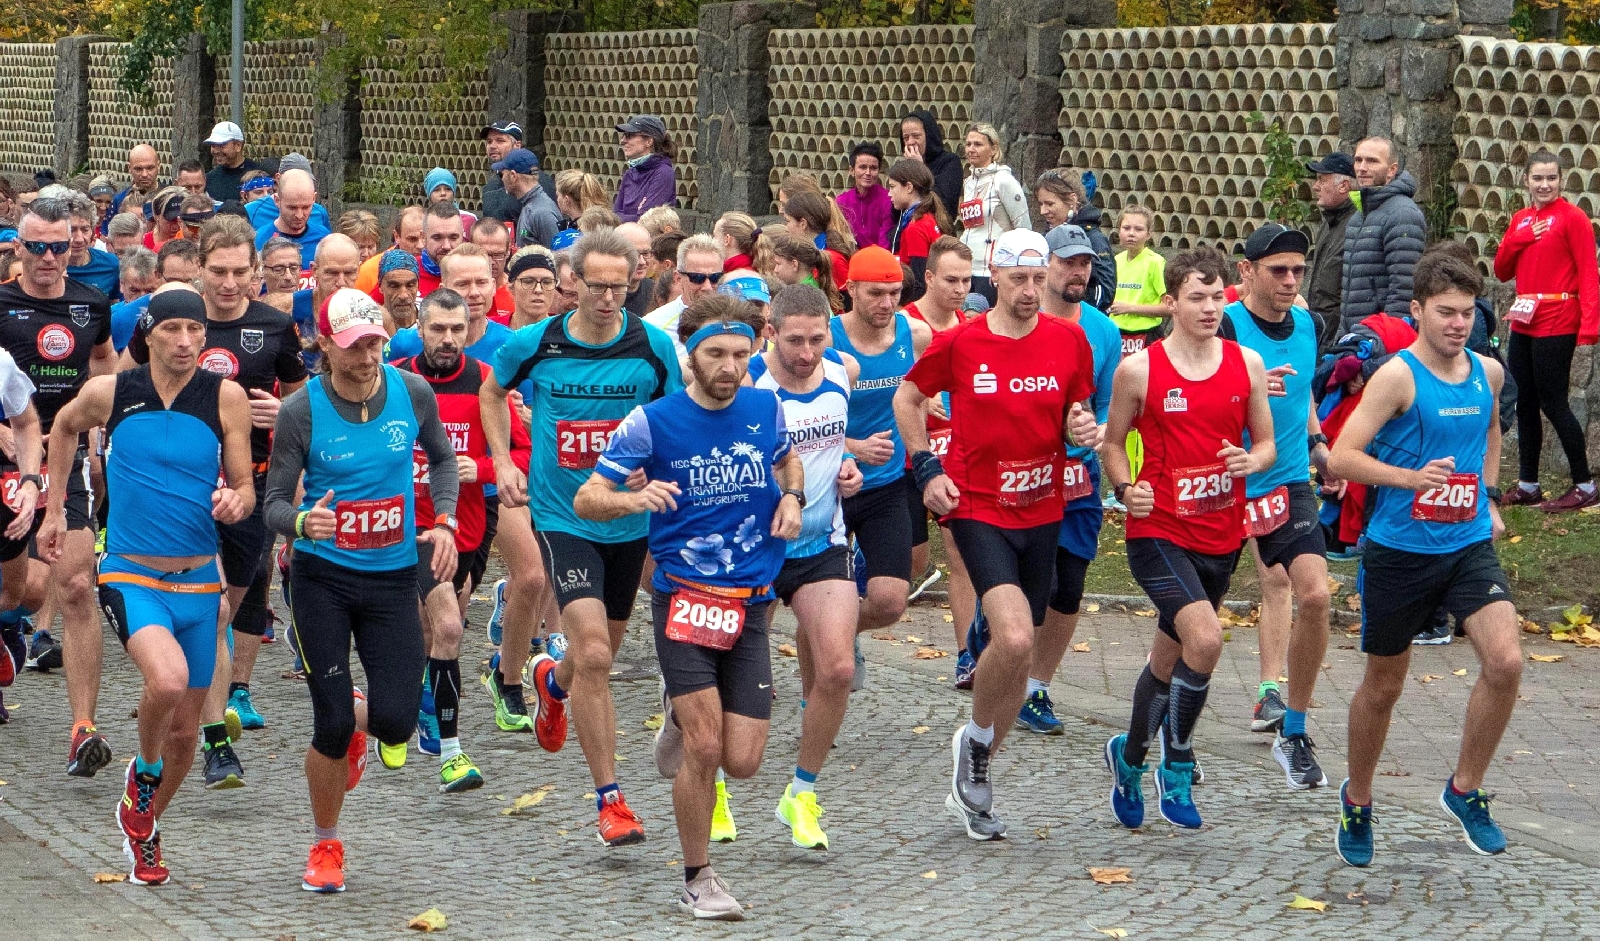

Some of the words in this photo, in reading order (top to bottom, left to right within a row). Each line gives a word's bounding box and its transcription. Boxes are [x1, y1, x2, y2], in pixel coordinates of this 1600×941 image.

[41, 366, 78, 376] Helios
[604, 384, 637, 395] BAU
[853, 376, 905, 390] URAWASSE
[1009, 376, 1059, 392] OSPA
[796, 414, 829, 427] TEAM
[930, 434, 952, 456] 22
[671, 459, 690, 469] HSG
[1000, 464, 1053, 492] 2232
[1063, 464, 1085, 486] 97
[686, 482, 742, 496] TRIATHLON
[1177, 471, 1233, 501] 2236
[1418, 483, 1476, 508] 2205
[693, 493, 750, 506] LAUFGRUPPE
[1243, 494, 1286, 525] 113
[340, 506, 402, 533] 2126
[557, 568, 589, 588] LSV
[672, 599, 740, 634] 2098
